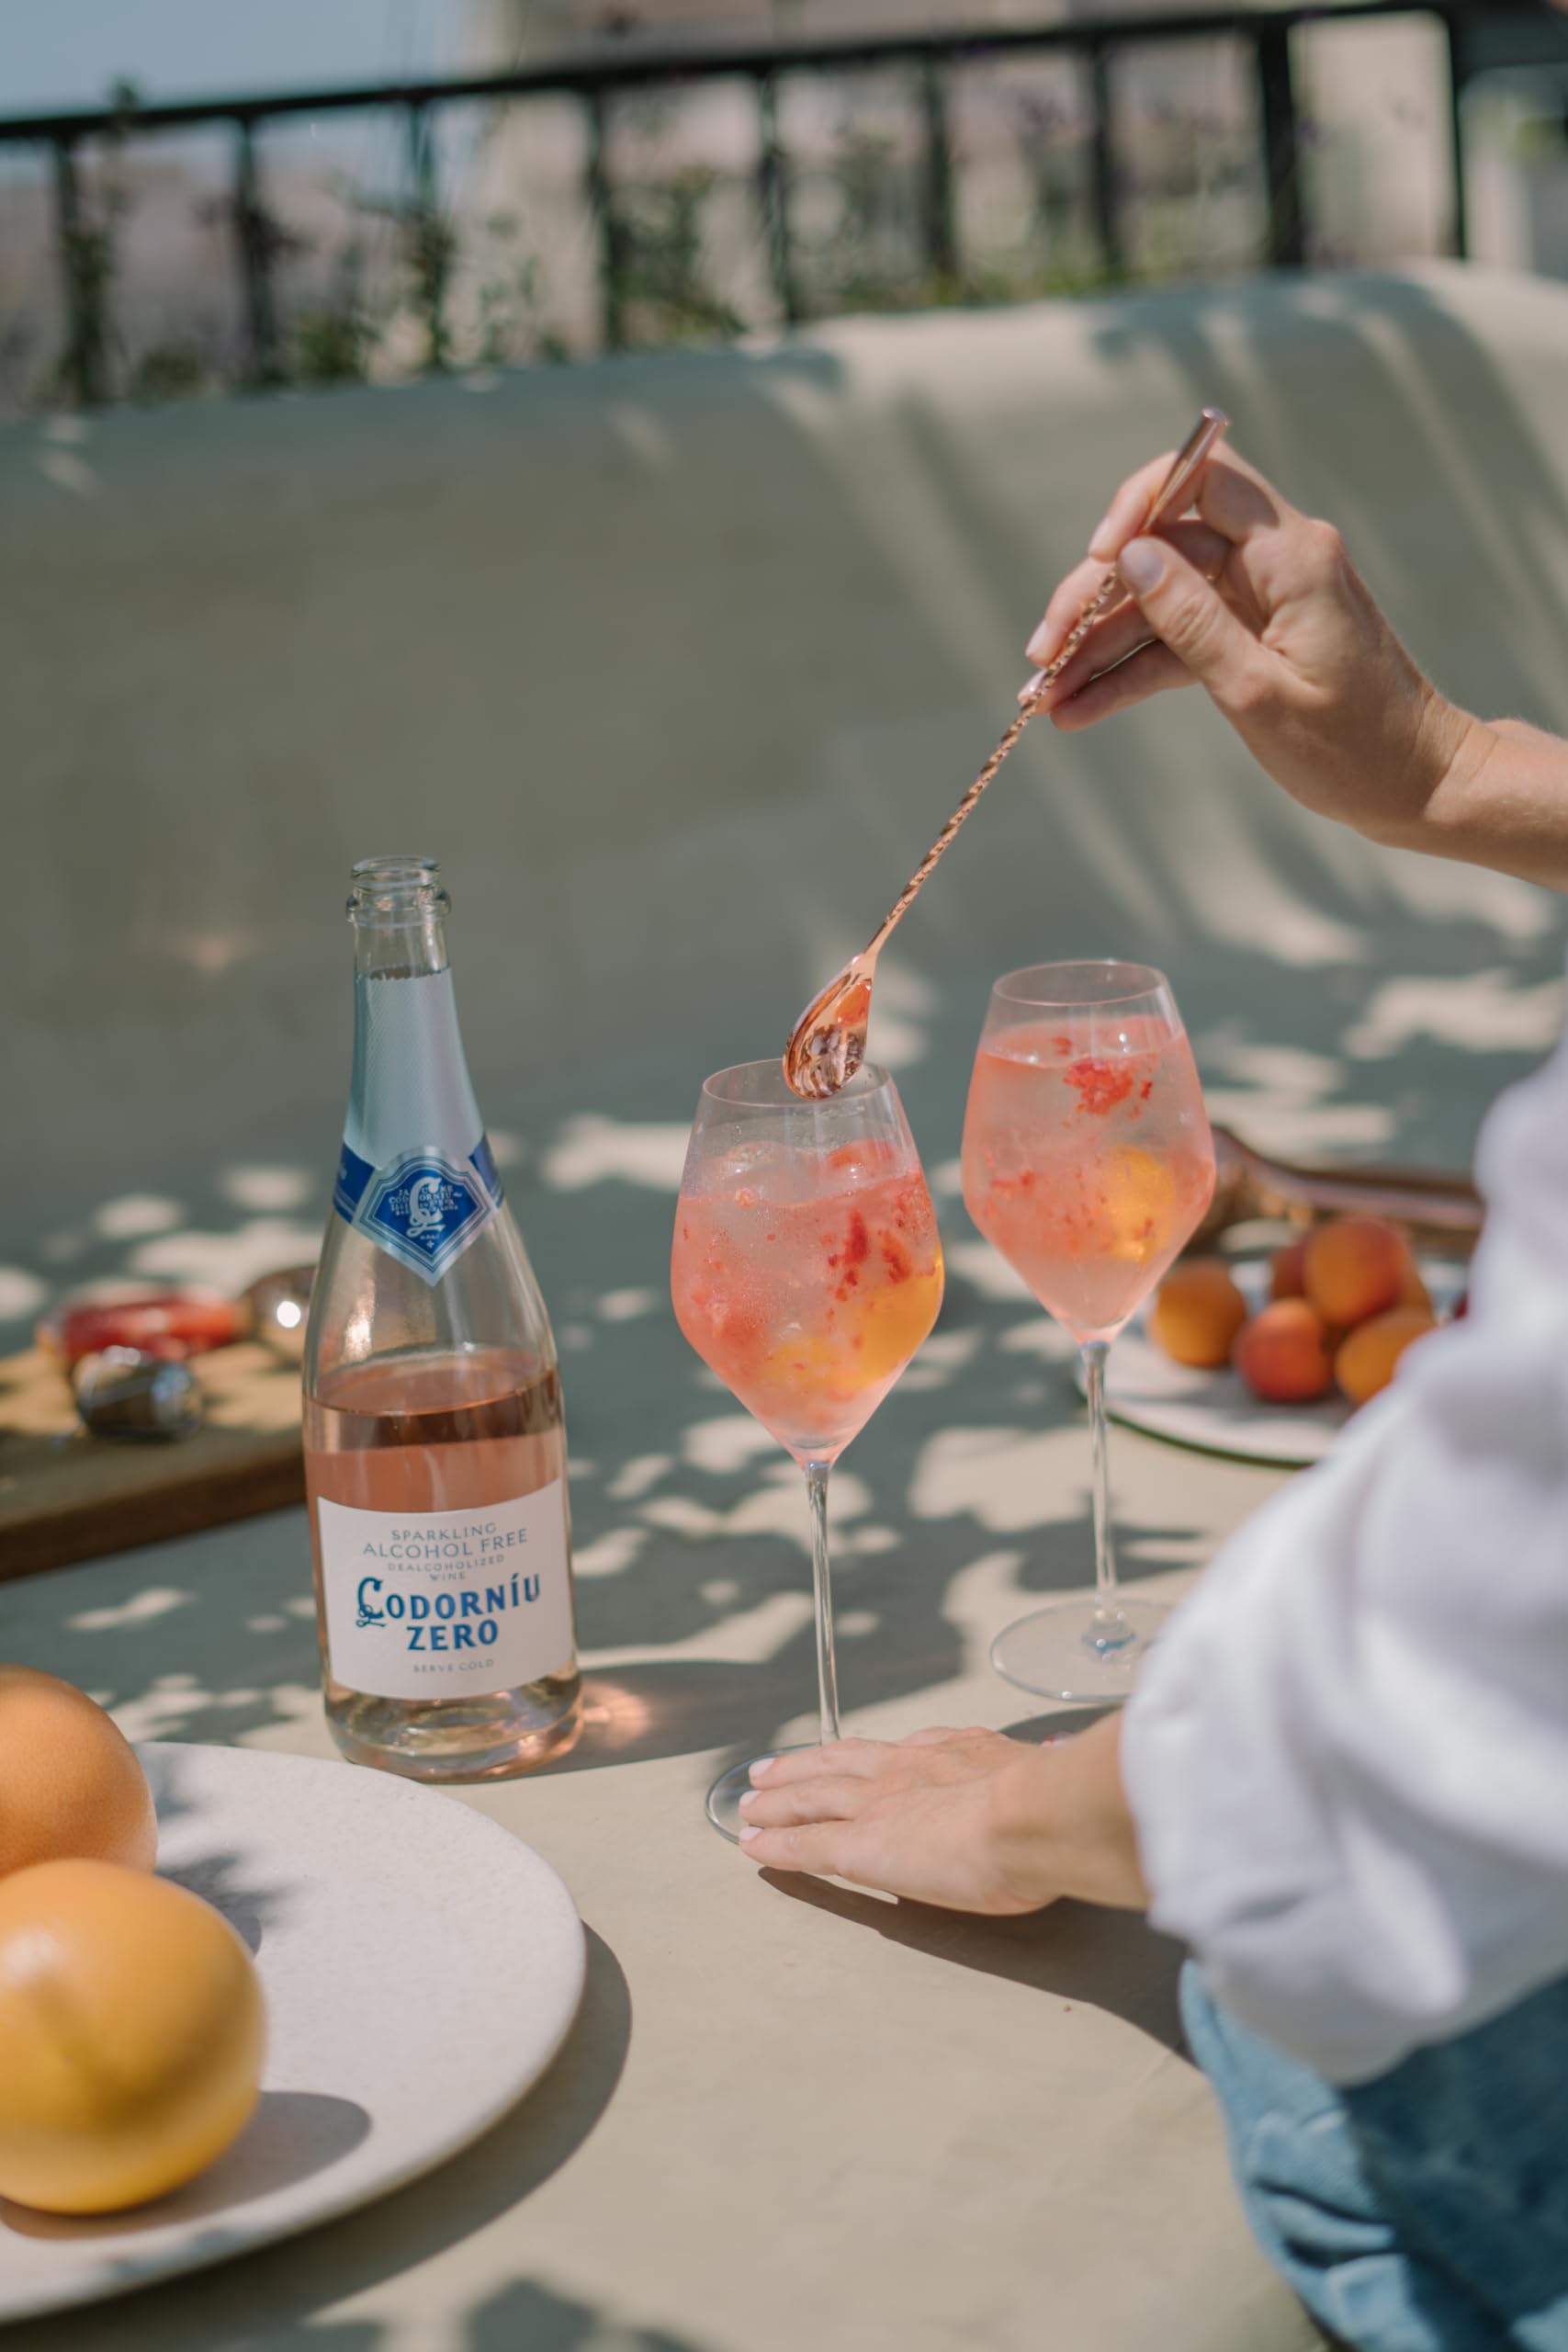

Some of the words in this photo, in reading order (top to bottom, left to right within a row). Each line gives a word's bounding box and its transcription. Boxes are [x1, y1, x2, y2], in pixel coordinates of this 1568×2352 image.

[391, 1522, 497, 1542] SPARKLING
[363, 1543, 474, 1559] ALCOHOL
[480, 1528, 527, 1554] FREE
[388, 1554, 505, 1572] DEALCOHOLIZED
[429, 1572, 467, 1581] WINE
[355, 1572, 540, 1628] CODORNÍU
[406, 1619, 499, 1651] ZERO
[413, 1663, 454, 1673] SERVE
[458, 1658, 495, 1671] COLD
